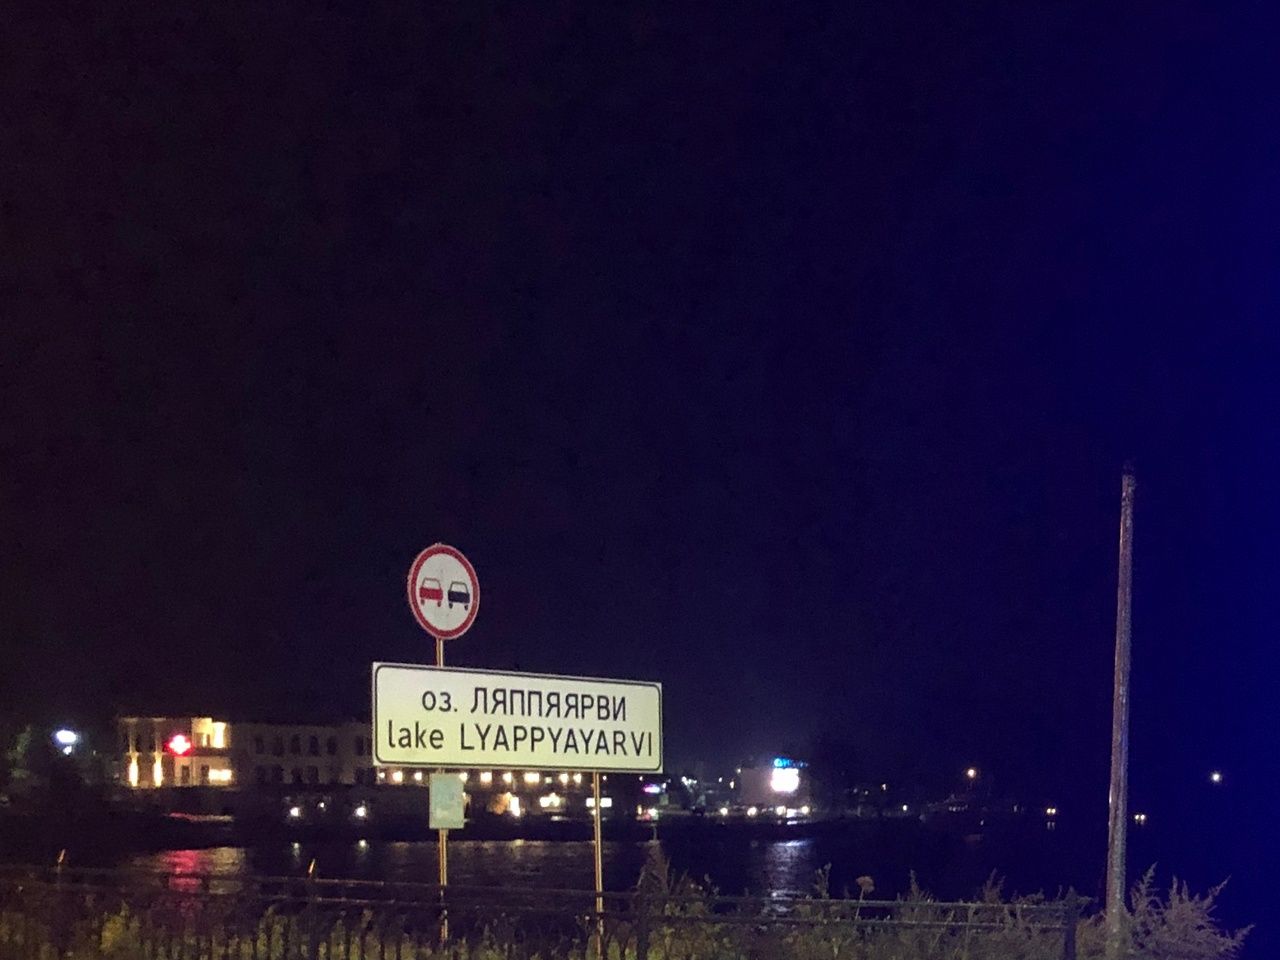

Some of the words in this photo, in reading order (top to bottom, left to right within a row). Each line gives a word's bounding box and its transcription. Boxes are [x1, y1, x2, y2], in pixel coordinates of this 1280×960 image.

[422, 691, 458, 713] оз.
[470, 687, 627, 721] ЛЯППЯЯРВИ
[388, 720, 444, 749] lake
[460, 723, 653, 757] LYAPPYAYARVI
